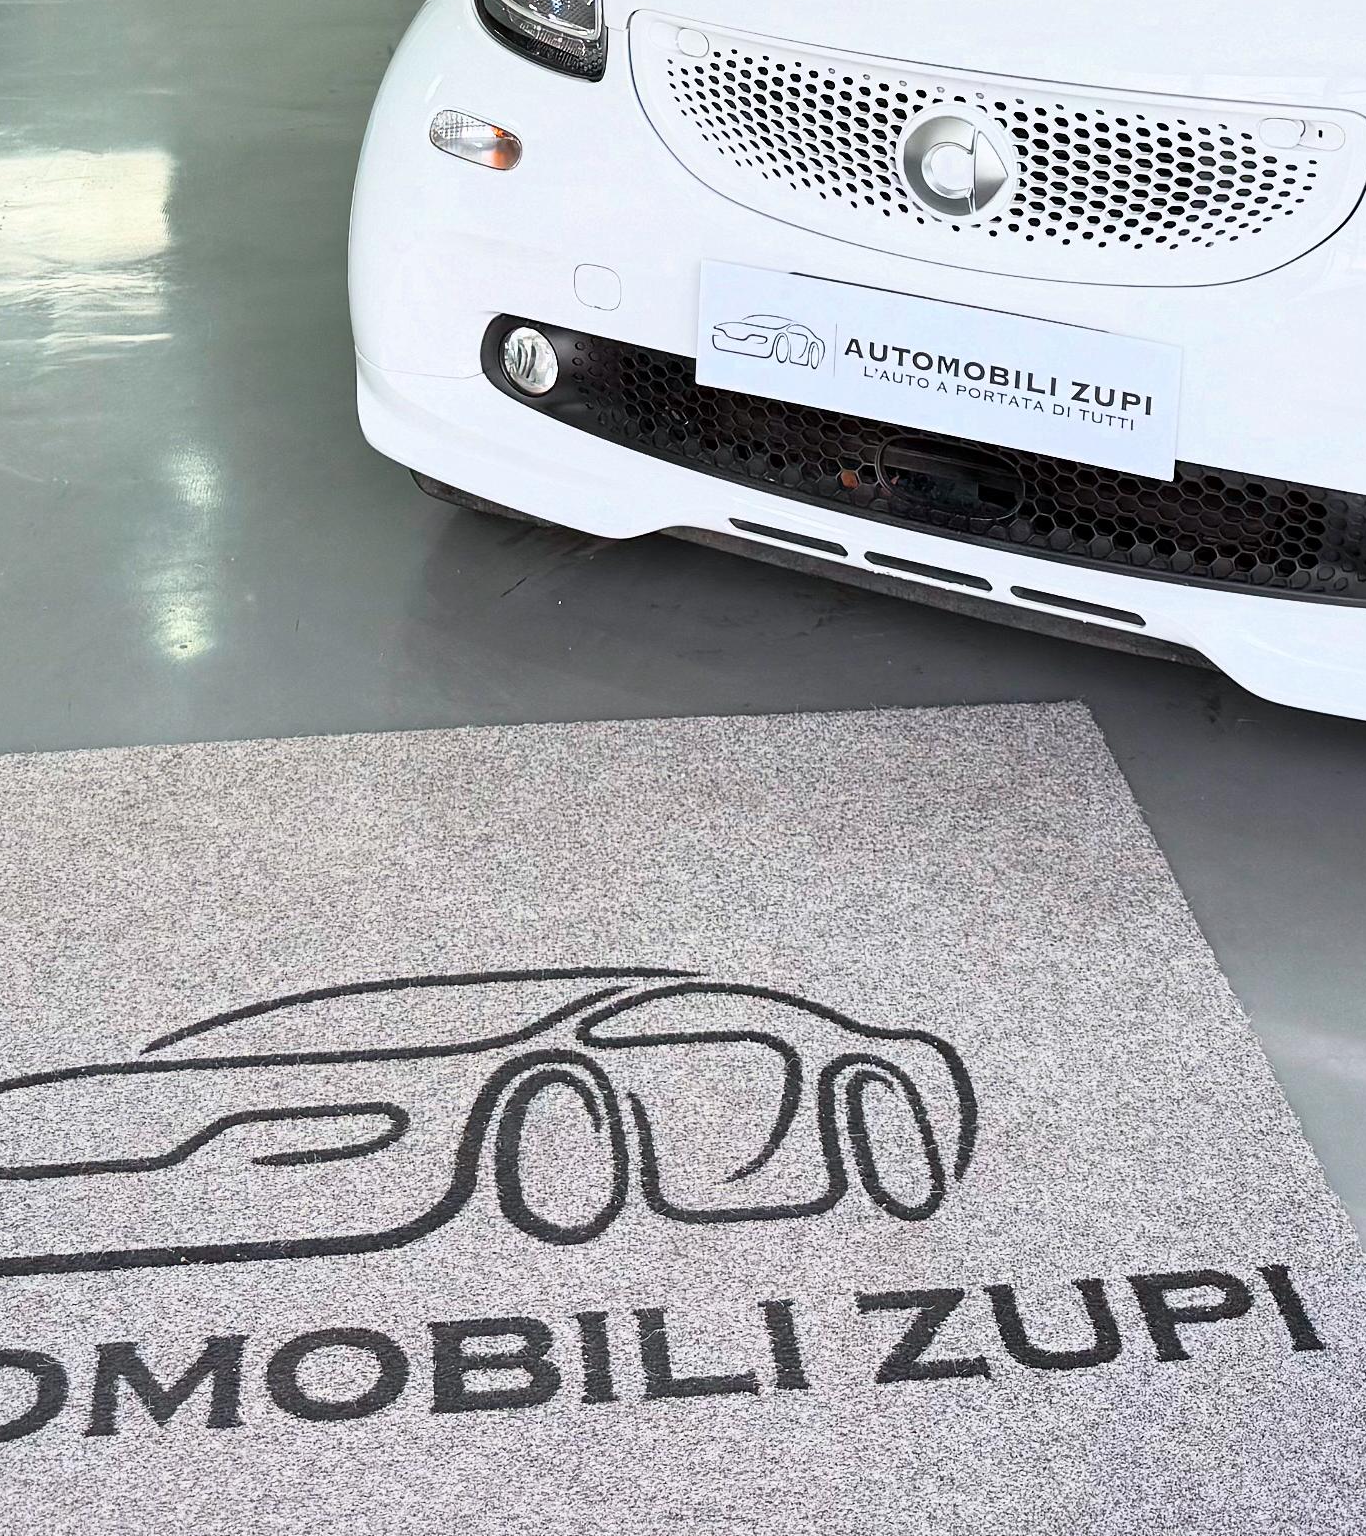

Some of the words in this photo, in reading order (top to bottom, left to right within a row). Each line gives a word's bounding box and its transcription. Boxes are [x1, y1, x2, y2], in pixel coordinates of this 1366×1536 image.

[844, 338, 1057, 397] AUTOMOBILI
[1070, 381, 1152, 416] ZUPI
[863, 366, 929, 389] L'AUTO
[936, 382, 948, 394] A
[956, 384, 1045, 413] PORTATA
[1053, 404, 1071, 418] DI
[1079, 409, 1135, 431] TUTTI
[855, 1262, 1330, 1384] ZUPI
